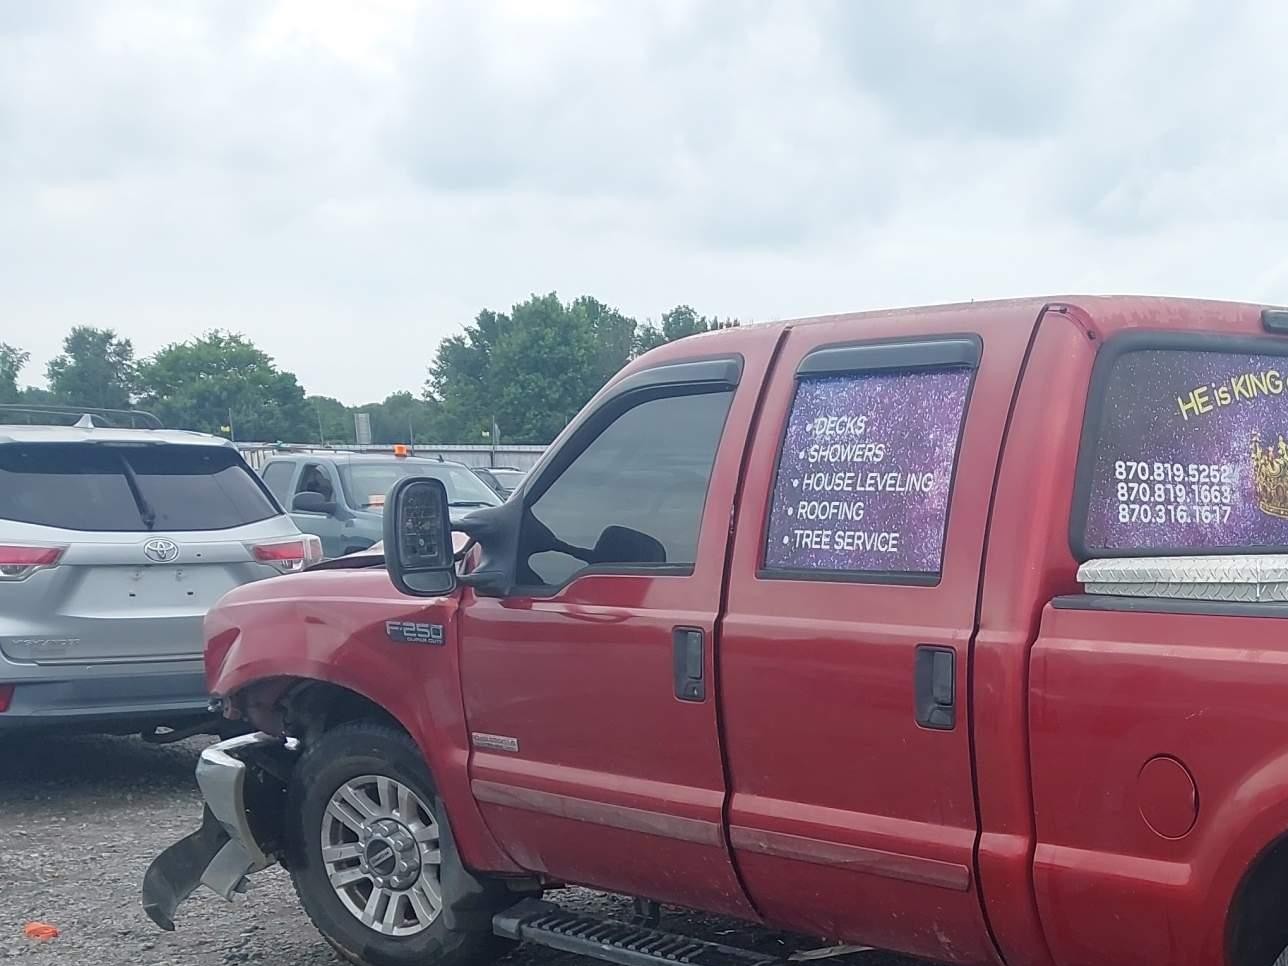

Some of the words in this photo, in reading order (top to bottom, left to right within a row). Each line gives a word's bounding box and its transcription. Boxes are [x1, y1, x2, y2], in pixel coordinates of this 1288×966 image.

[1178, 386, 1213, 420] HE
[1211, 382, 1231, 406] is
[1231, 370, 1283, 400] KING
[814, 416, 868, 434] DECKS
[808, 443, 885, 463] SHOWERS
[803, 473, 855, 491] HOUSE
[856, 473, 934, 492] LEVELING
[797, 501, 864, 520] ROOFING
[1118, 503, 1231, 524] 870.316.1617
[795, 530, 830, 549] TREE
[834, 531, 899, 552] SERVICE
